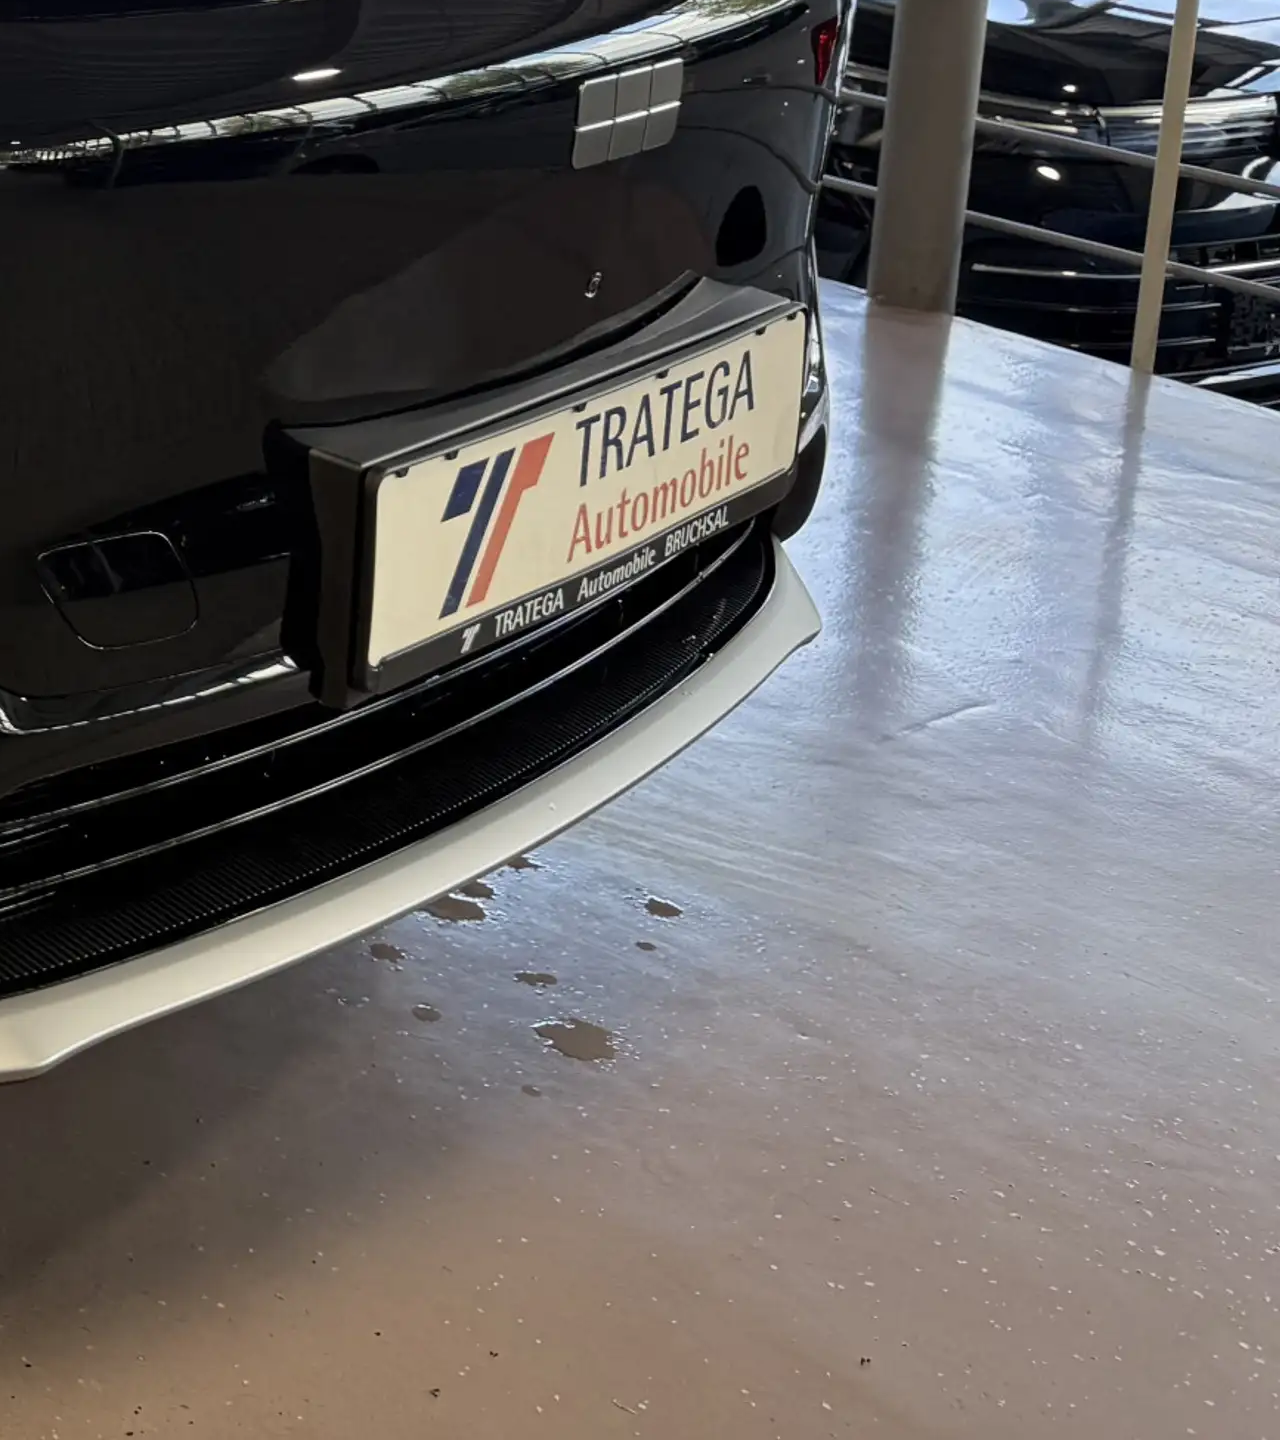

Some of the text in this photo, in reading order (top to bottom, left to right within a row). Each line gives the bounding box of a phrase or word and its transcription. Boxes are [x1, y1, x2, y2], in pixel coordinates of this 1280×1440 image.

[575, 350, 754, 487] TRATEGA
[566, 434, 750, 564] Automobile
[495, 504, 729, 638] TRATEGA Automobile BRUCHSAL
